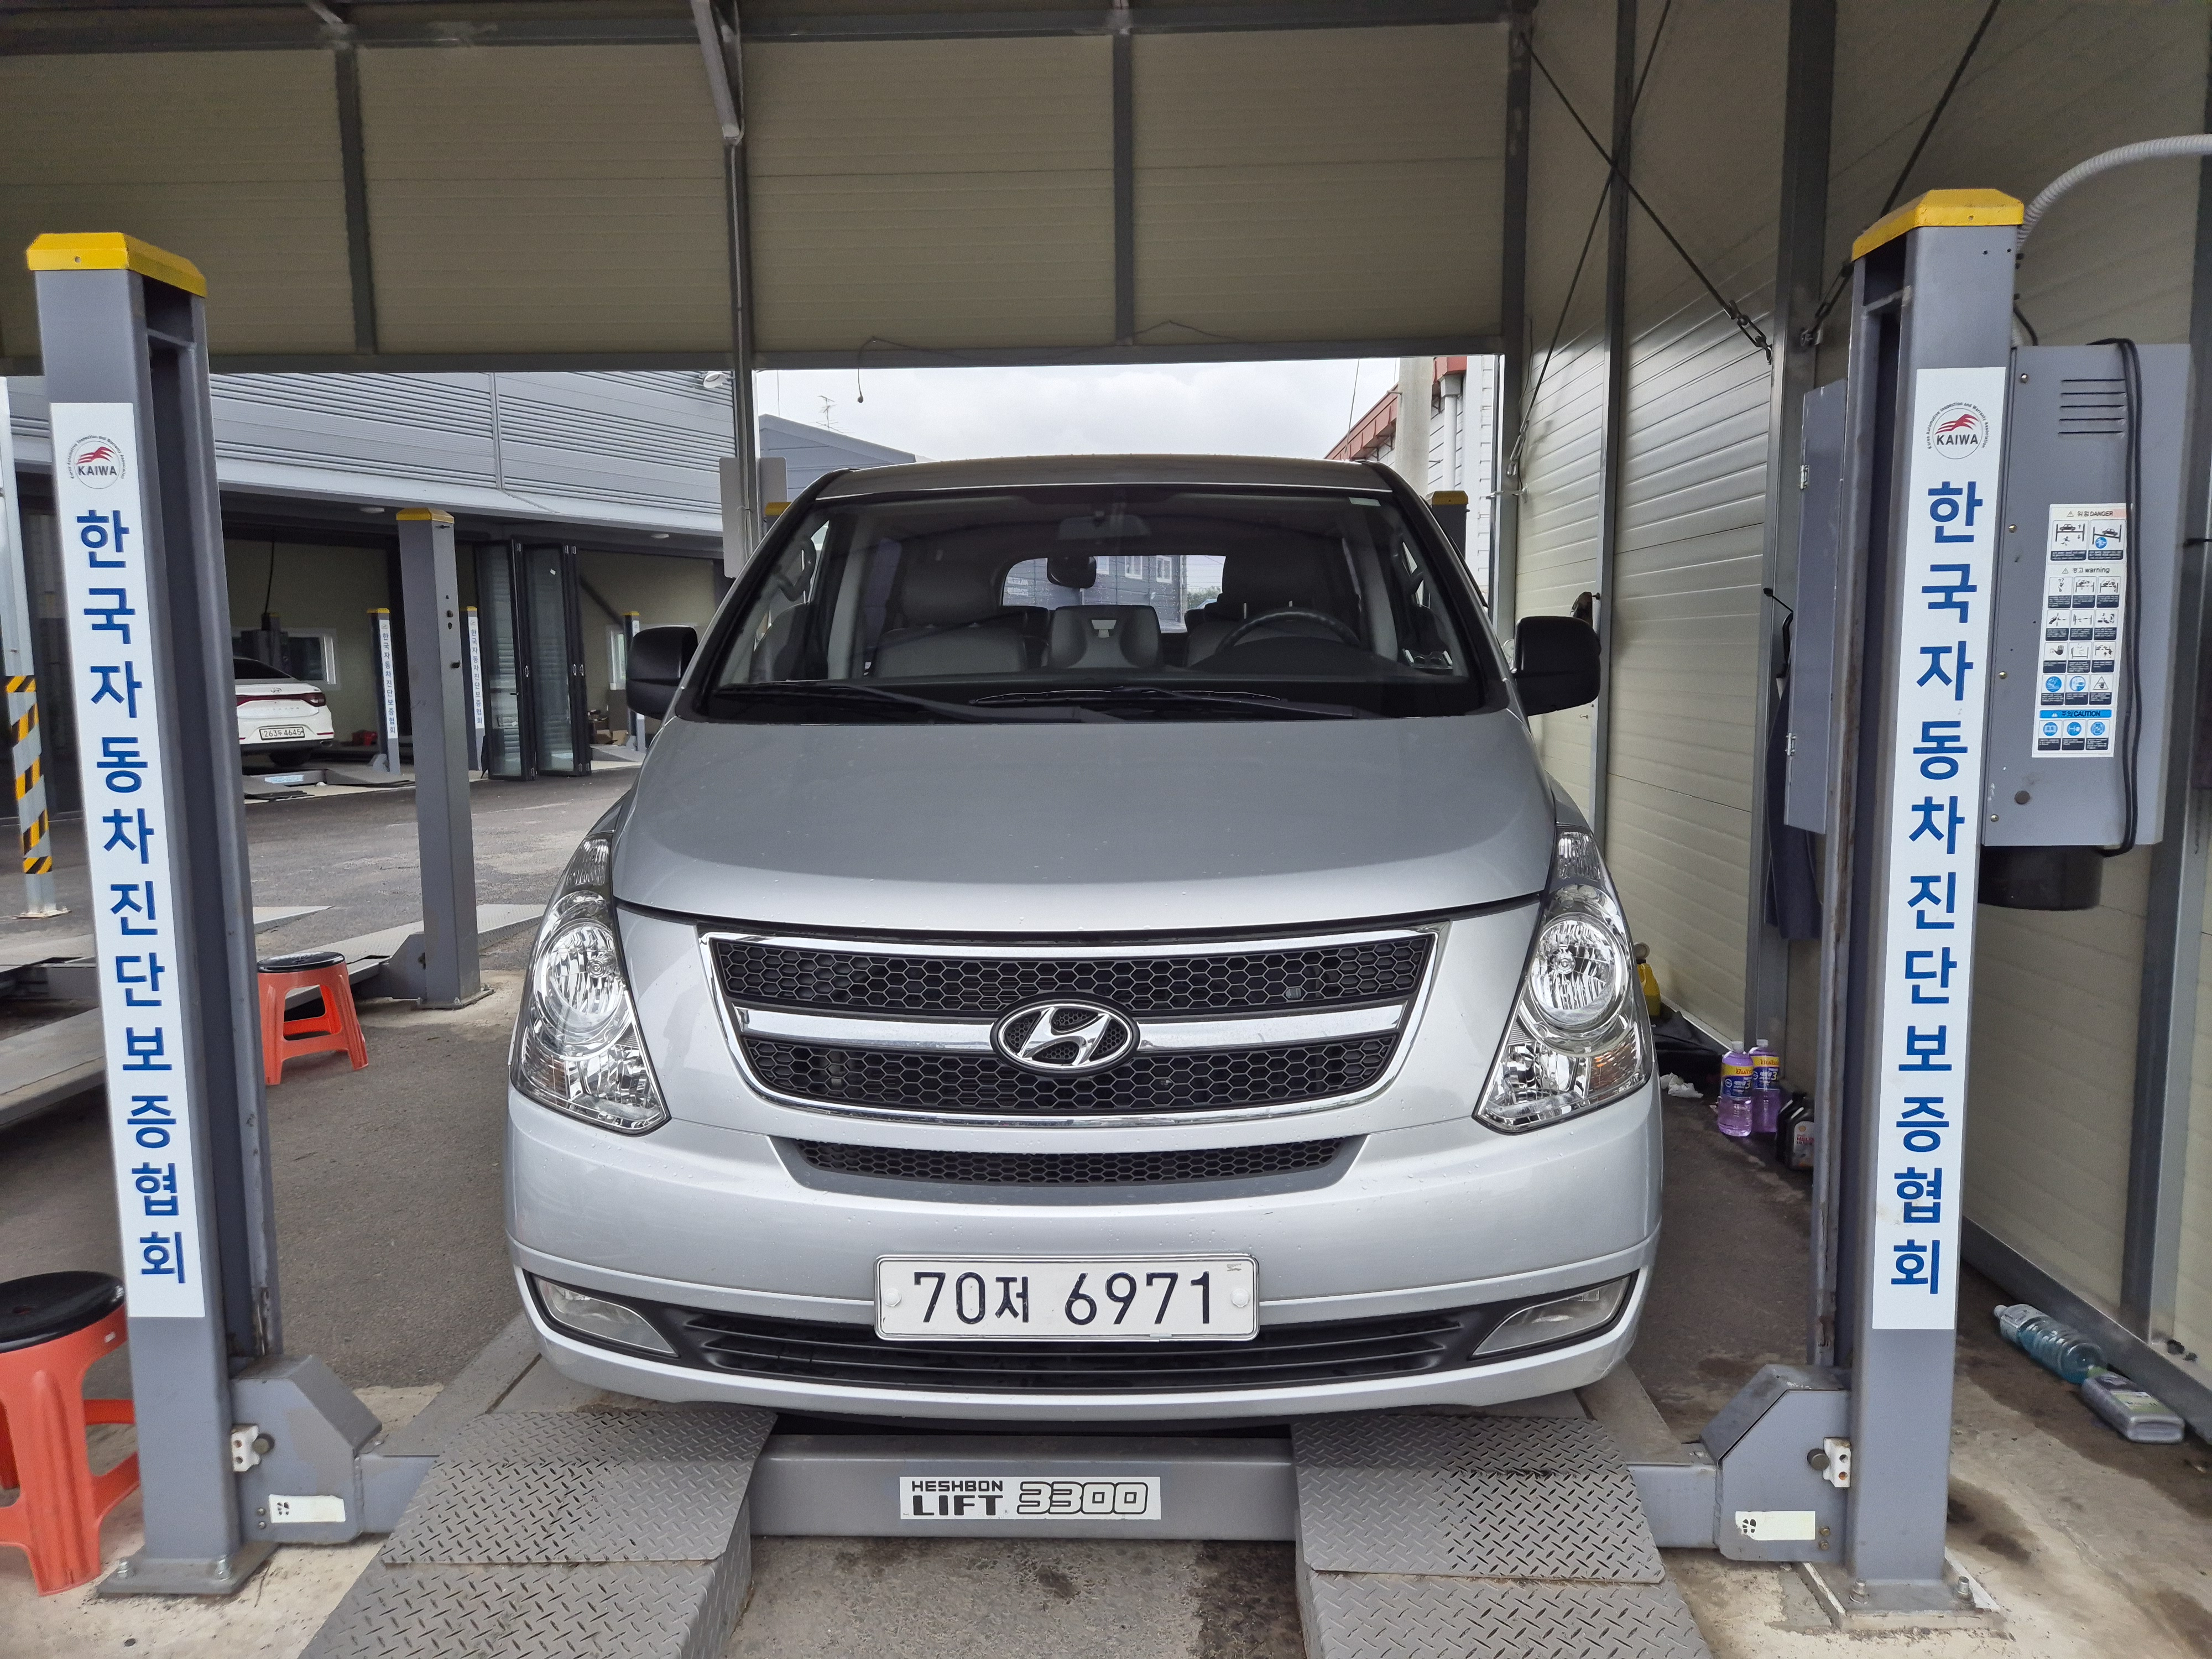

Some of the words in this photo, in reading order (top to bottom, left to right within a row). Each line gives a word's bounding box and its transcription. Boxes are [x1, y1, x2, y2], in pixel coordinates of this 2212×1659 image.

[1937, 434, 1978, 445] KAIWA
[78, 465, 118, 476] KAIWA
[76, 509, 186, 1285] 한국자동차진단보증협회
[1891, 481, 1984, 1295] 한국자동차진단보증협회
[913, 1271, 1030, 1324] 70저
[1064, 1271, 1210, 1326] 6971
[911, 1480, 1003, 1492] HESHBON
[912, 1495, 1003, 1516] LIFT
[1016, 1481, 1149, 1515] 3300
